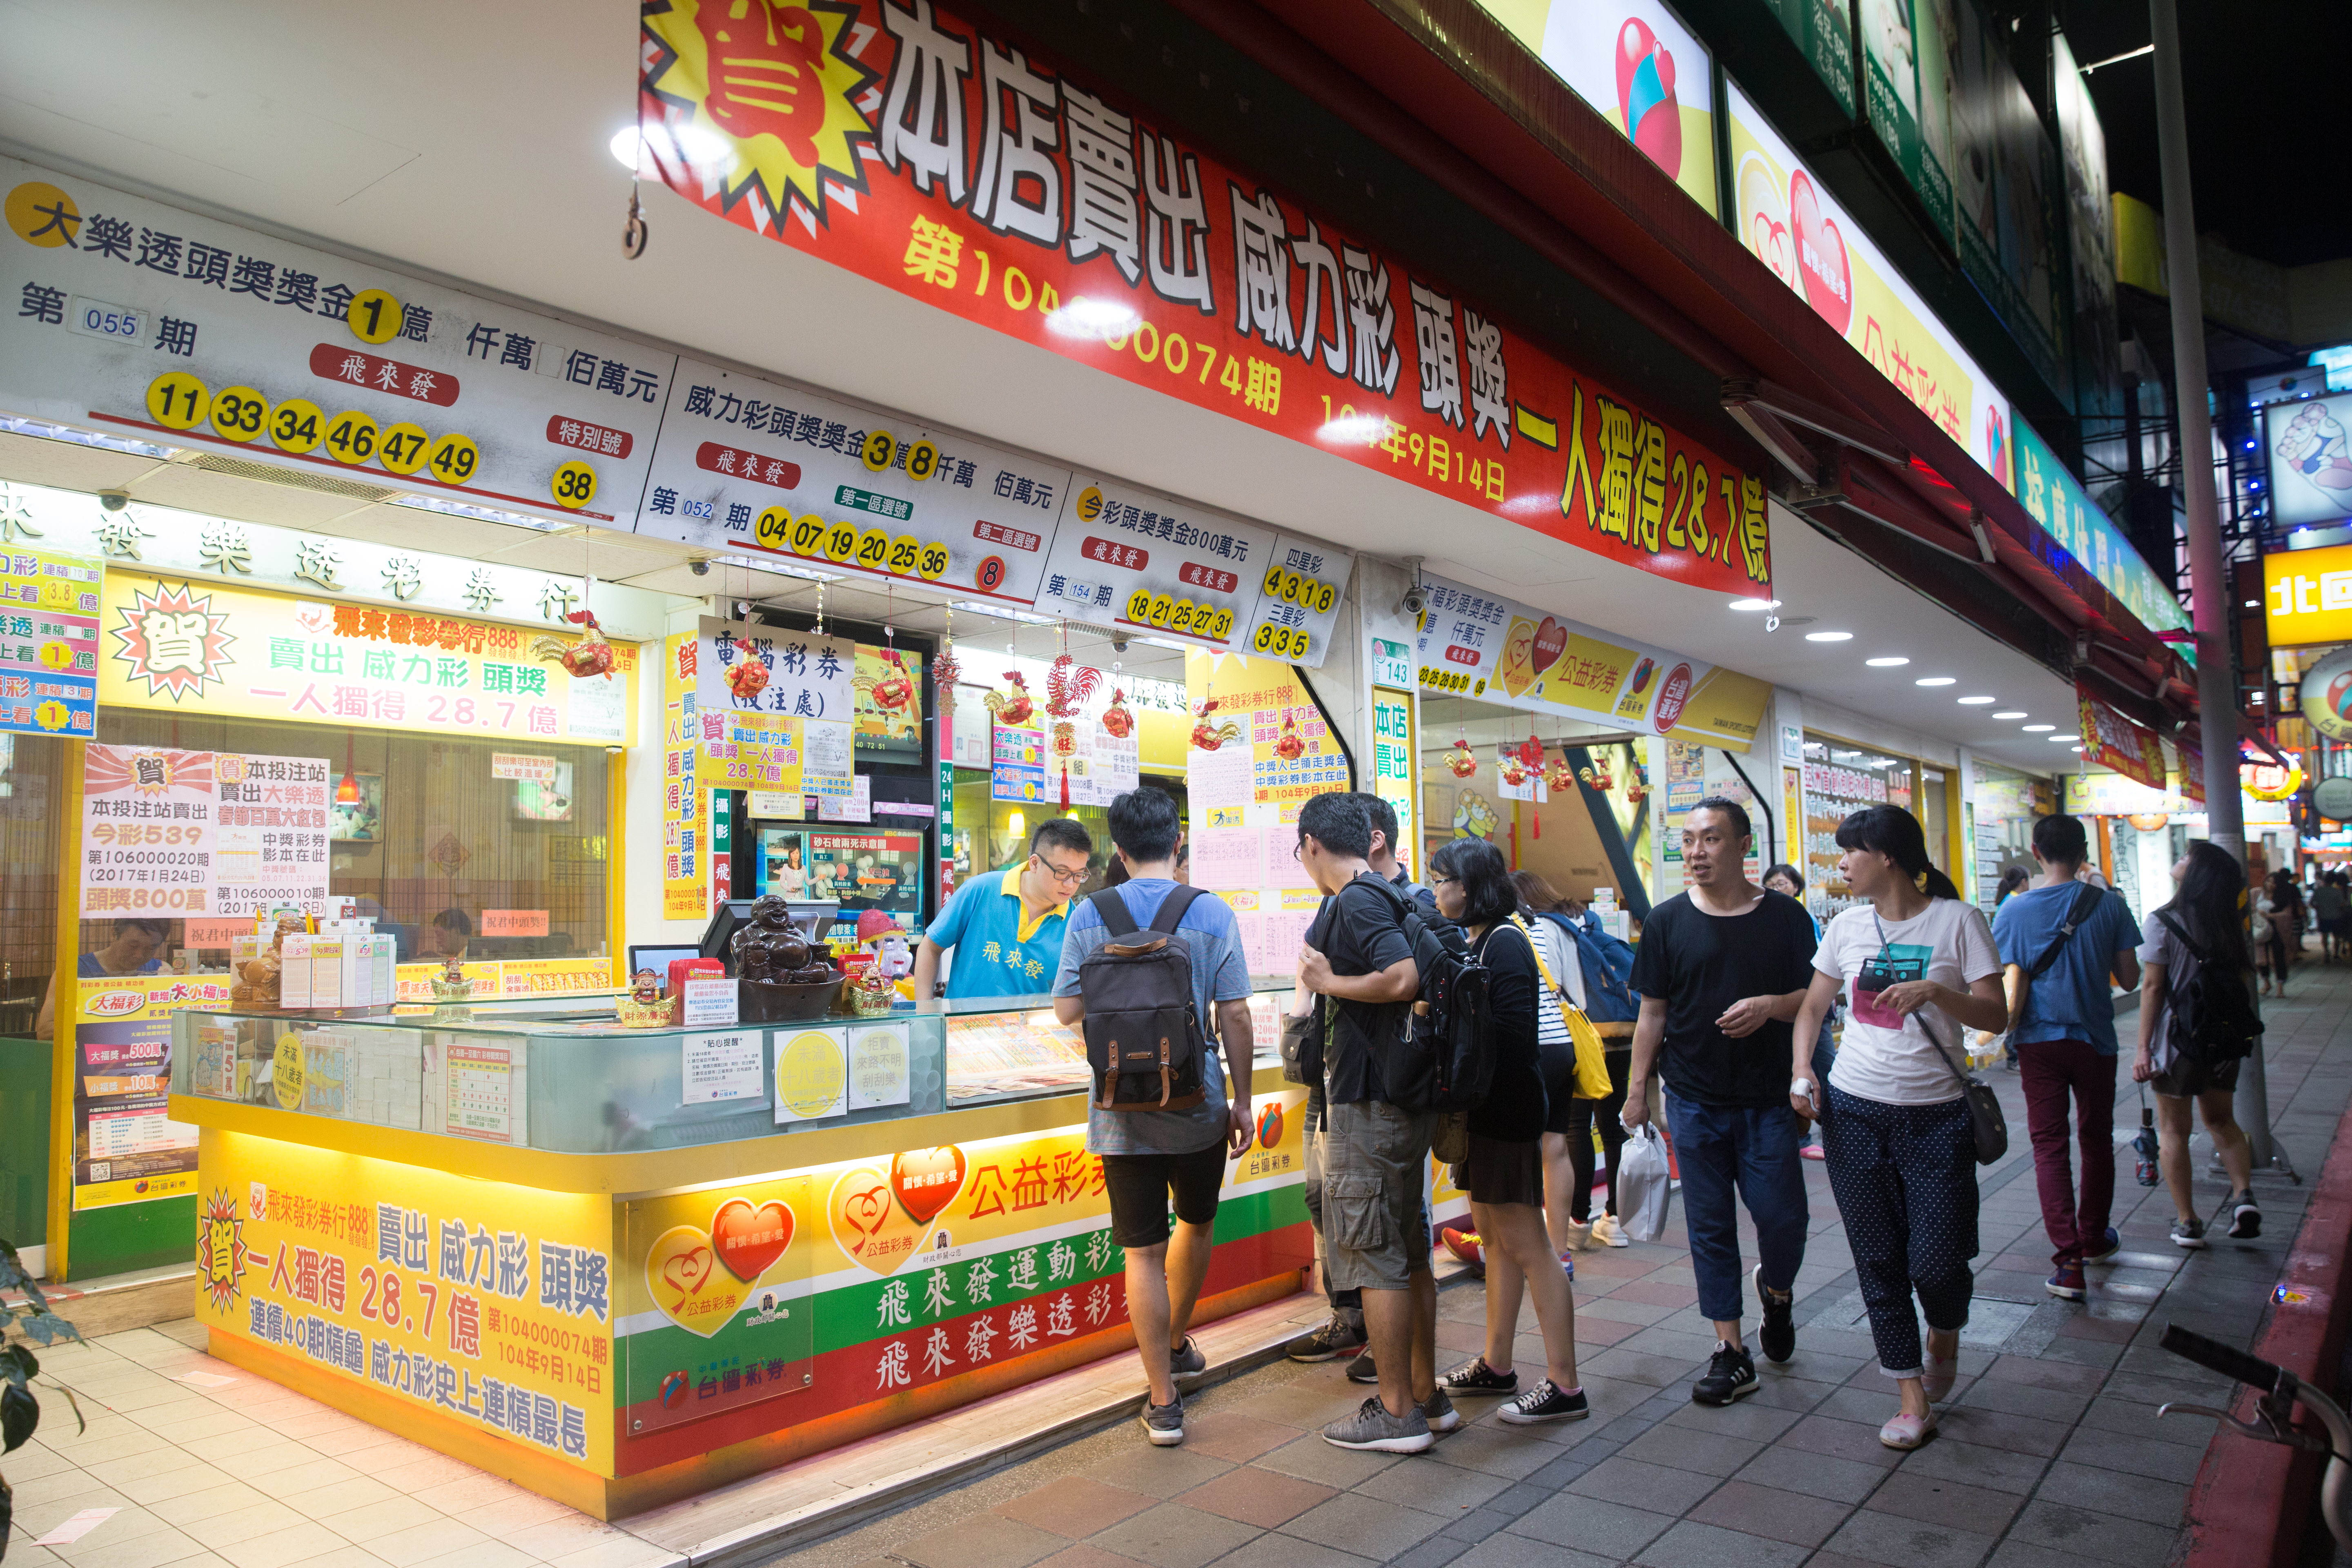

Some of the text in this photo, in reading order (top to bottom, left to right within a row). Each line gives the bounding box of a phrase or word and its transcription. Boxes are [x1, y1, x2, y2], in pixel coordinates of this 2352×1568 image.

[880, 0, 1213, 315] 本店賣出
[1227, 183, 1401, 399] 威力彩
[1408, 274, 1512, 450] 頭獎
[18, 281, 198, 357] 第 055 期
[903, 214, 1281, 415] 第10400074期
[466, 322, 536, 371] 仟萬
[566, 350, 658, 403] 佰萬元
[340, 354, 437, 400] 飛來發
[160, 384, 475, 477] 11 33 34 46 47 49
[559, 421, 623, 455] 特別號
[716, 449, 785, 485] 飛來發
[558, 470, 592, 501] 38
[994, 470, 1053, 510] 佰萬元
[840, 488, 908, 519] 第一區選號
[760, 513, 944, 574] 04 07 19 20 25 36
[977, 523, 1036, 550] 第二區選號
[1094, 541, 1229, 590] 飛來發 飛來發
[1286, 548, 1323, 574] 四星彩
[984, 562, 998, 586] 8
[50, 582, 71, 601] 3.8
[1133, 596, 1229, 634] 18 21 25 27 31
[1268, 603, 1305, 628] 三星彩
[333, 605, 518, 655] 飛來發彩券行 888
[1451, 620, 1486, 647] 仟萬元
[138, 608, 213, 676] 賀
[270, 636, 548, 697] 賣出 威力彩 頭獎
[1451, 648, 1474, 663] 飛來發
[1387, 661, 1407, 683] 143
[1419, 668, 1485, 694] 23 25 28 30 31 09
[1558, 655, 1619, 694] 公益彩券
[249, 682, 405, 722] 一人獨得
[740, 715, 782, 730] 飛來發彩券行
[1253, 710, 1277, 725] 賣出
[1375, 702, 1407, 738] 本店
[733, 728, 792, 746] 賣出 威力彩
[995, 732, 1022, 746] 大樂透
[1058, 737, 1071, 751] 旺
[1254, 727, 1279, 742] 頭獎
[494, 755, 554, 769] 刮刮樂可至室內刮
[710, 742, 798, 765] 頭獎 一人獨得
[995, 747, 1023, 760] 頭獎上看
[1255, 754, 1347, 773] 中獎人已領走獎金
[1376, 744, 1408, 780] 賣出
[247, 760, 326, 782] 本投注站
[504, 767, 543, 779] 比較溫暖
[727, 762, 782, 782] 28.7億
[801, 777, 852, 788] 中獎人已領走獎金
[994, 767, 1022, 782] 大福彩
[1256, 769, 1347, 787] 中獎彩券影本在此
[220, 782, 325, 805] 賣出大樂透
[702, 778, 799, 792] 第104000074期 104年9月14日
[801, 786, 853, 796] 中獎彩券影本在此
[994, 784, 1022, 797] 頭獎上看
[92, 799, 208, 820] 本投注站賣出
[218, 806, 326, 828] 春節百萬大紅包
[681, 748, 695, 878] 威力彩 頭獎
[91, 823, 203, 846] 今彩539
[263, 833, 326, 848] 中獎彩券
[813, 837, 887, 850] 砂石槍兩死示意圖
[88, 850, 209, 866] 第106000020期
[263, 847, 326, 862] 影本在此
[89, 868, 205, 884] (2017年1月24日)
[86, 888, 206, 912] 頭獎800萬
[217, 886, 325, 900] 第106000010期
[1230, 895, 1258, 907] 大福彩
[982, 940, 1044, 980] 飛來發
[90, 994, 145, 1011] 大福彩
[283, 1044, 297, 1063] 未滿
[797, 1044, 826, 1063] 未滿
[868, 1036, 890, 1052] 拒賣
[91, 1050, 119, 1062] 大福獎
[857, 1053, 901, 1071] 來路不明
[275, 1061, 303, 1087] 十八歲者
[782, 1065, 841, 1087] 十八歲者
[862, 1071, 896, 1088] 刮刮樂
[90, 1082, 118, 1094] 小福獎
[1250, 1154, 1291, 1176] 台灣彩券
[268, 1189, 368, 1240] 飛來發彩券行 888
[209, 1216, 236, 1289] 賀
[866, 1235, 914, 1259] 公益彩券
[922, 1248, 962, 1265] 財政部關心您
[377, 1203, 609, 1322] 賣出 威力彩 頭獎
[247, 1241, 345, 1313] 一人獨得
[877, 1229, 1119, 1330] 飛來發運動彩
[687, 1294, 737, 1318] 公益彩券
[746, 1309, 789, 1327] 財政部關心您
[488, 1305, 608, 1366] 第104000074期
[876, 1283, 1122, 1391] 飛來發樂透彩
[250, 1298, 587, 1460] 連續40期槓龜 威力彩史上連槓最長
[498, 1341, 601, 1395] 104年9月14日
[698, 1358, 786, 1401] 台灣彩券
